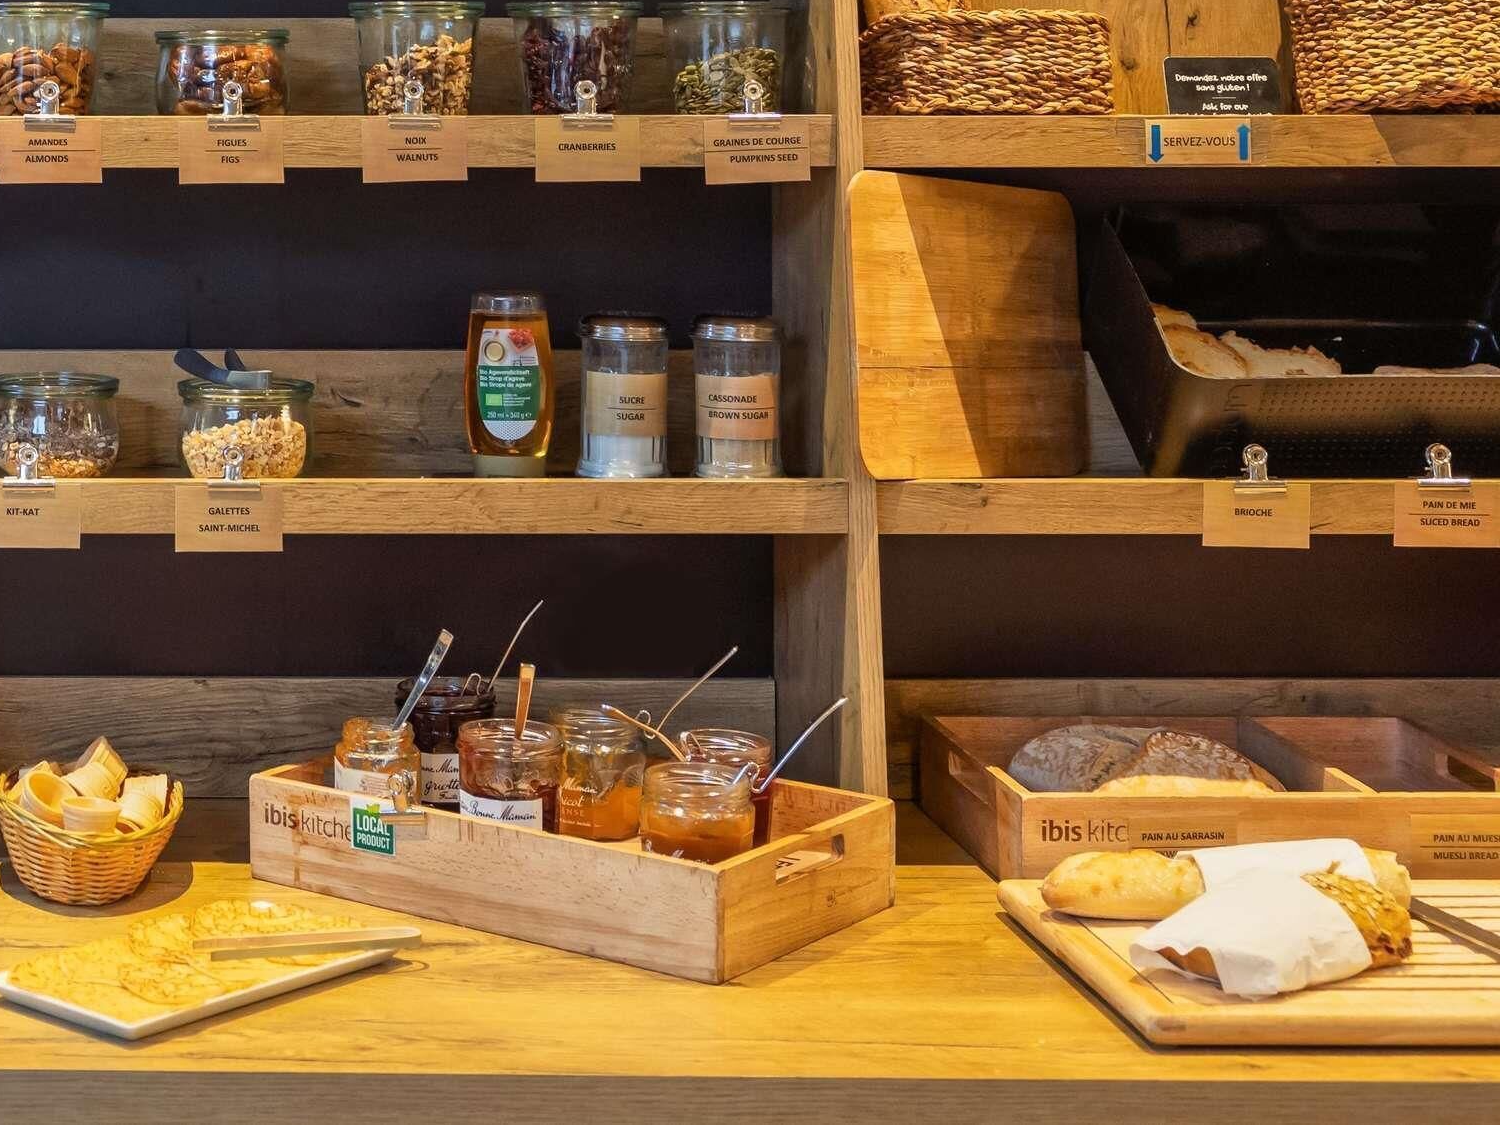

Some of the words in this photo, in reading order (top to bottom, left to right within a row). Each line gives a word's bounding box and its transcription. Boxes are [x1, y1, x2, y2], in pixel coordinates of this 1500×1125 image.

[1175, 74, 1219, 82] Demandez
[1221, 74, 1245, 82] notre
[1217, 84, 1245, 93] gluten
[28, 138, 68, 147] AMANDES
[217, 138, 248, 147] FIGUES
[405, 136, 427, 145] NOIX
[713, 137, 750, 147] GRAINES
[752, 137, 765, 146] DE
[766, 136, 802, 146] COURGE
[1163, 136, 1236, 147] SERVEZ-VOUS
[558, 142, 616, 151] CRANBERRIES
[25, 155, 69, 164] ALMONDS
[221, 155, 240, 164] FIGS
[396, 153, 439, 162] WALNUTS
[730, 154, 775, 163] PUMPKINS
[777, 153, 798, 162] SEED
[619, 396, 645, 404] SUCRE
[708, 394, 757, 404] CASSONADE
[616, 412, 645, 421] SUGAR
[708, 411, 741, 420] BROWN
[742, 411, 769, 420] SUGAR
[1422, 501, 1444, 510] PAIN
[1445, 501, 1458, 510] DE
[1459, 501, 1477, 510] MIE
[6, 507, 39, 516] KIT-KAT
[208, 506, 250, 516] GALETTES
[1234, 507, 1273, 517] BRIOCHE
[1420, 517, 1449, 527] SLICED
[1451, 518, 1480, 527] BREAD
[198, 523, 261, 533] SAINT-MICHEL
[470, 800, 495, 819] Bonne
[497, 804, 538, 821] Maman
[264, 803, 297, 830] ibis
[301, 809, 352, 843] kitche
[356, 813, 391, 835] LOCAL
[1041, 819, 1082, 842] ibis
[1088, 819, 1130, 842] kitc
[356, 832, 390, 850] PRODUCT
[1142, 833, 1163, 841] PAIN
[1166, 833, 1179, 841] AU
[1180, 832, 1225, 841] SARRASIN
[1433, 834, 1455, 843] PAIN
[1457, 834, 1470, 842] AU
[1472, 834, 1500, 842] MUES
[1433, 851, 1467, 859] MUESLI
[1469, 851, 1499, 859] BREAD
